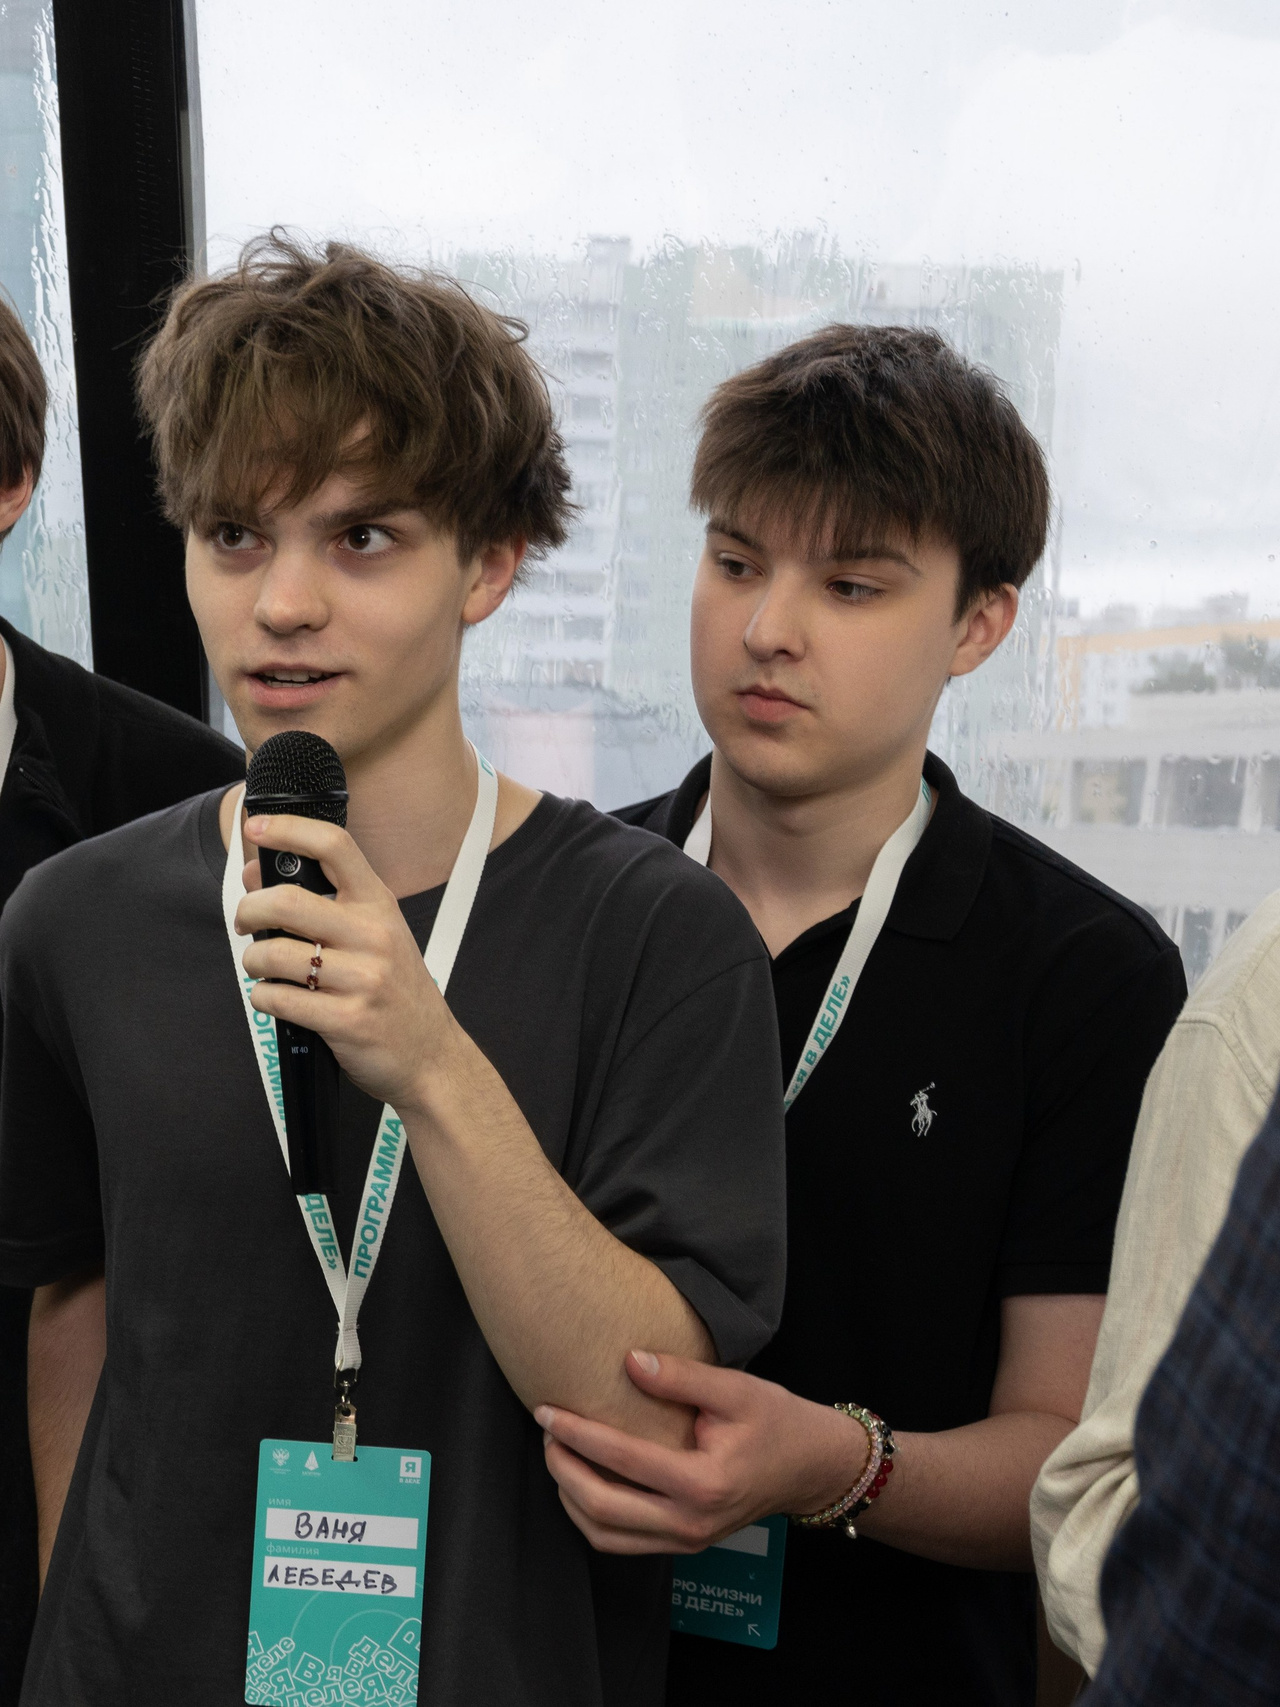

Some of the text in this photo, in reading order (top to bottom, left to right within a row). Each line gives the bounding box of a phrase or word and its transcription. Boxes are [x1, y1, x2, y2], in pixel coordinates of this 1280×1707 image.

[804, 1050, 817, 1066] В
[813, 975, 851, 1050] ДЕЛЕ»
[353, 1117, 403, 1279] ПРОГРАММА
[301, 1194, 339, 1270] ДЕЛЕ»
[268, 1498, 292, 1507] имя
[294, 1511, 367, 1544] ВАНЯ
[266, 1542, 320, 1556] фамилия
[267, 1564, 398, 1595] ЛЕБЕДЕВ
[700, 1583, 763, 1606] ЖИЗНИ
[685, 1596, 745, 1617] ДЕЛЕ»
